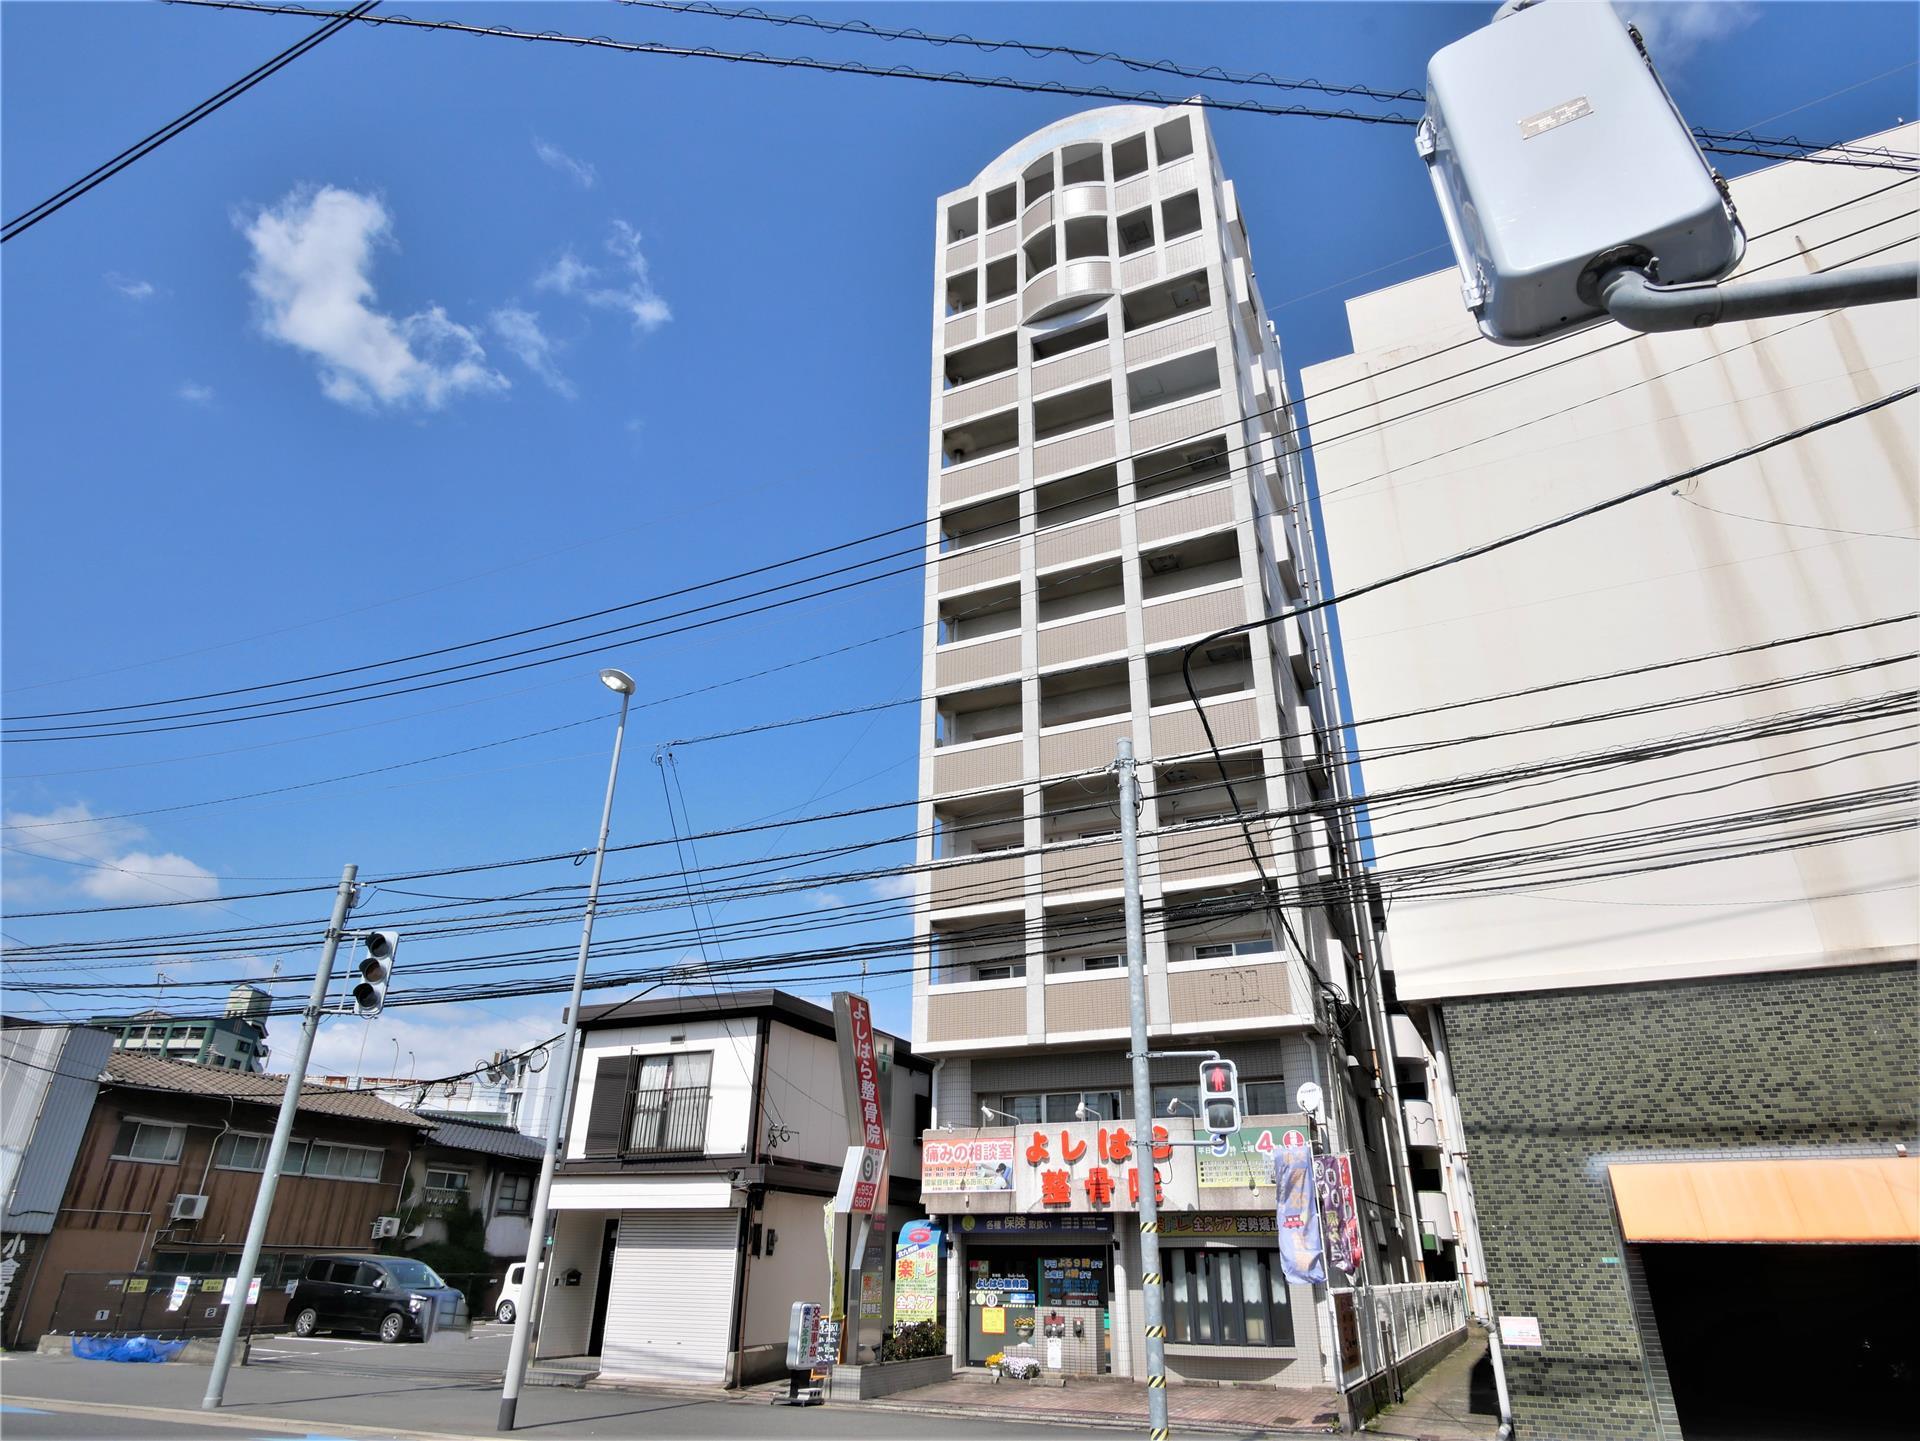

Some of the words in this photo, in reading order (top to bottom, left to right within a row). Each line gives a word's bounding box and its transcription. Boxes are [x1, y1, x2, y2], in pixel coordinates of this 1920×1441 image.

[853, 1001, 881, 1145] よしはら整骨院
[926, 1142, 1012, 1162] 痛みの相談室
[861, 1184, 873, 1196] 952
[207, 1308, 215, 1317] 2
